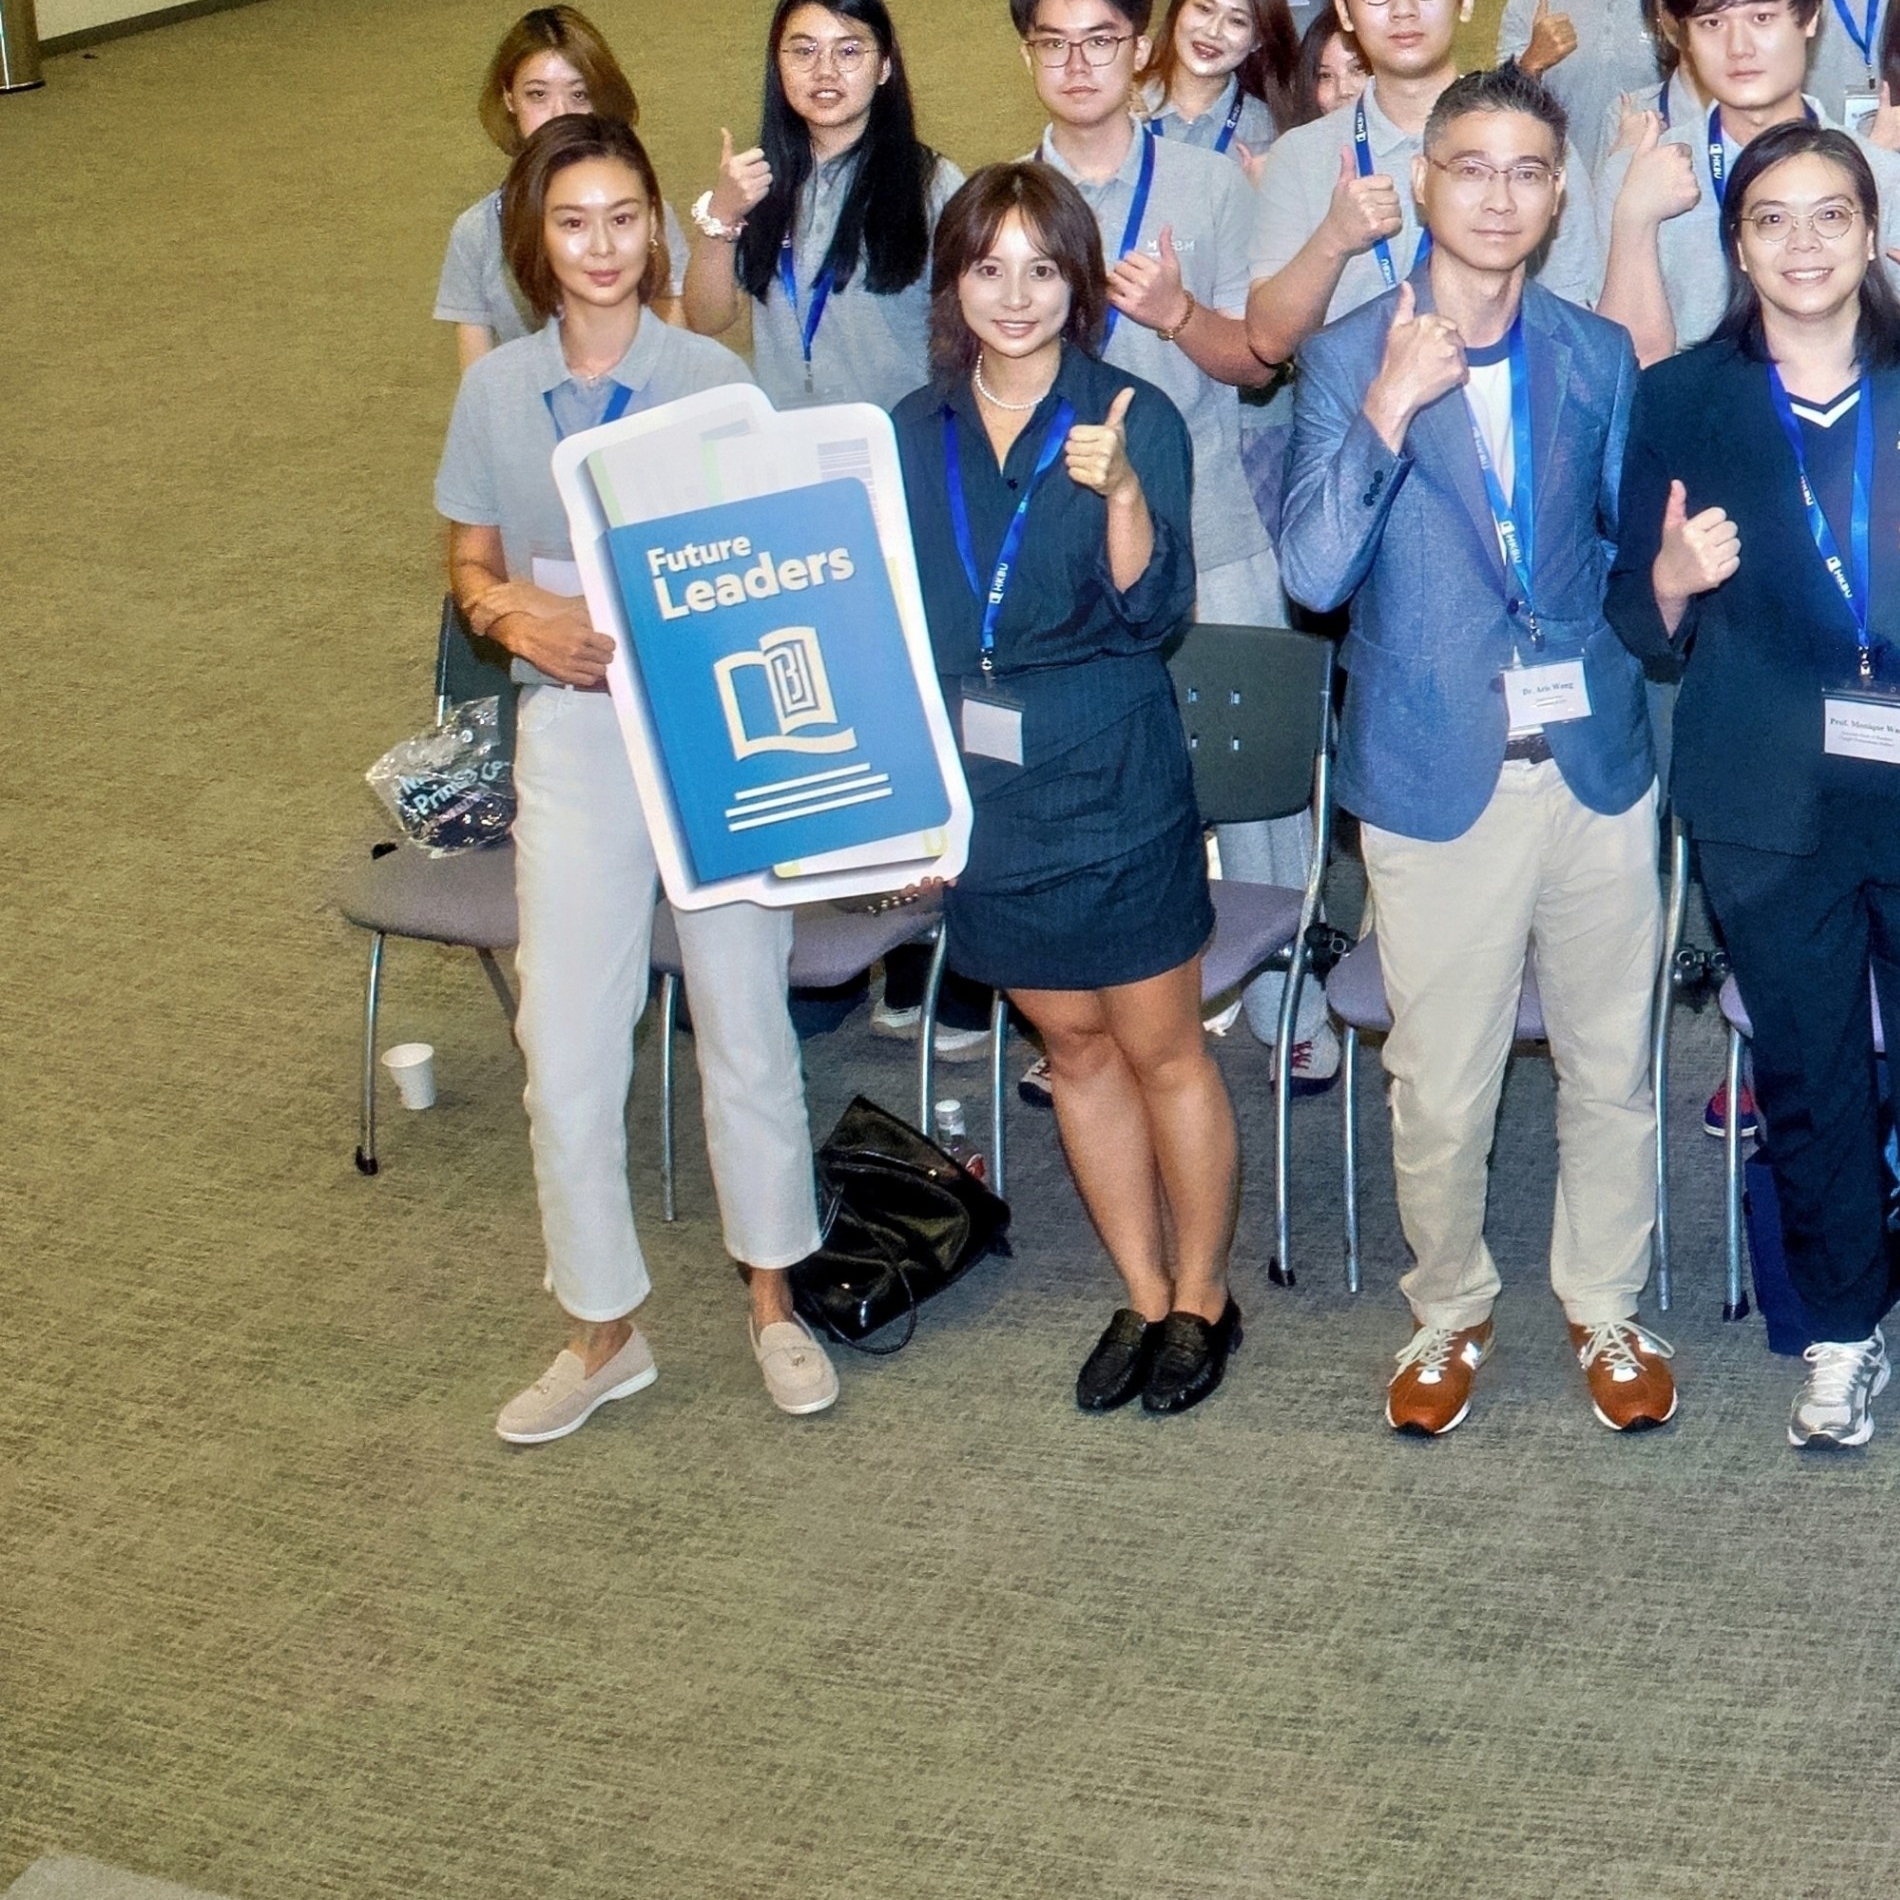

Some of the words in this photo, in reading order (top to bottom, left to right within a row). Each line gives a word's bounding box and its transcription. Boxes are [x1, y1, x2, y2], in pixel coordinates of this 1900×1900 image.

[1712, 154, 1724, 180] HKBU
[646, 534, 752, 577] Future
[1506, 533, 1523, 564] HKBU
[652, 546, 856, 622] Leaders
[991, 562, 1008, 592] HKBU
[1832, 569, 1853, 598] HKBU
